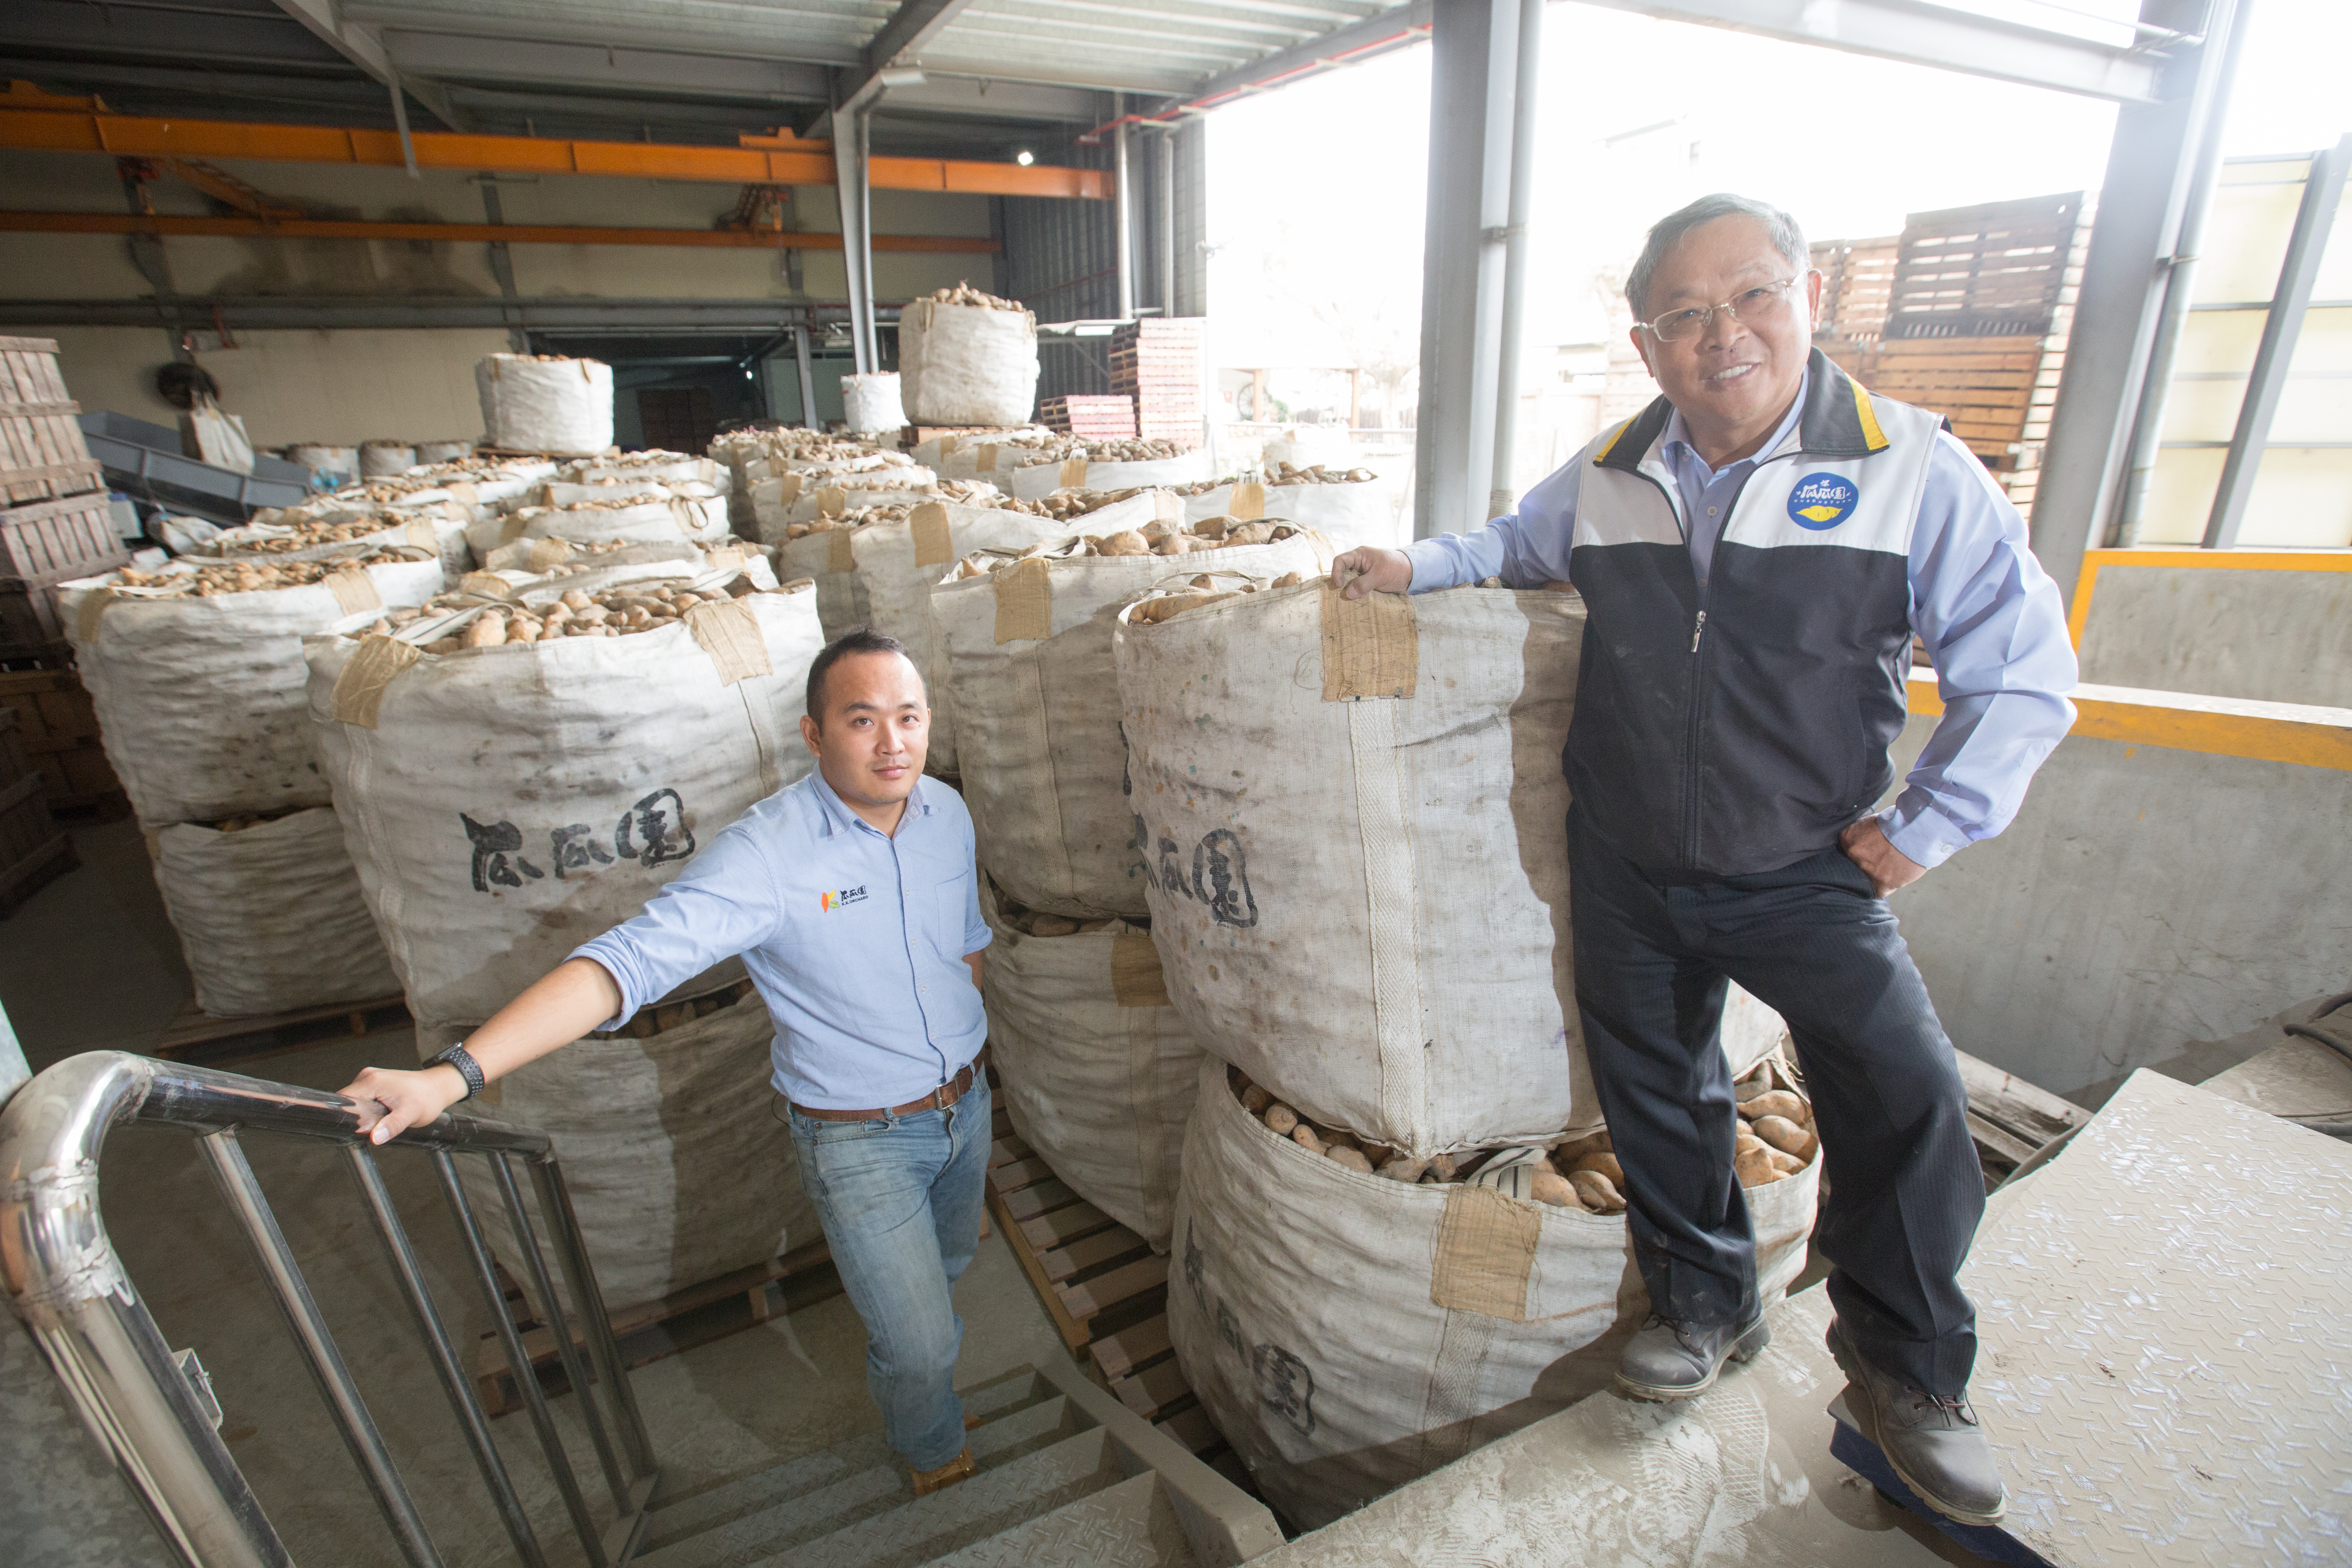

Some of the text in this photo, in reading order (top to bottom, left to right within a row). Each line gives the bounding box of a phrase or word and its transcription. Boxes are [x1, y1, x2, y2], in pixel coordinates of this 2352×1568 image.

[1800, 484, 1846, 499] 瓜瓜園
[459, 788, 695, 892] 瓜瓜園
[840, 885, 866, 902] 瓜瓜園
